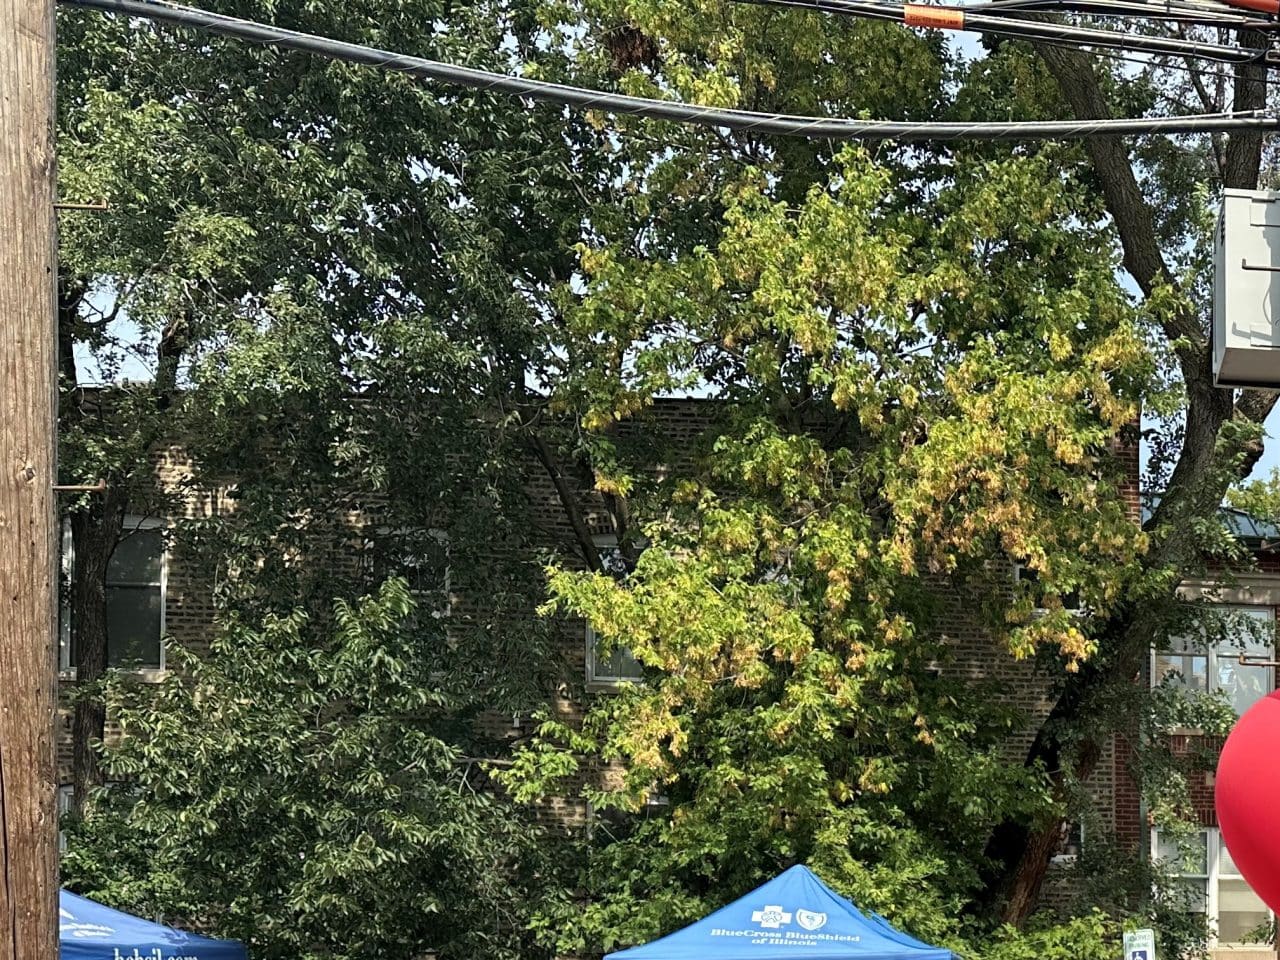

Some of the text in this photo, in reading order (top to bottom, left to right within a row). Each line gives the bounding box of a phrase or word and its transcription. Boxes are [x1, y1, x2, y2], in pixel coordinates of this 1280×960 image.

[710, 928, 861, 942] BlueCross BlueShield
[769, 938, 817, 946] Illinois
